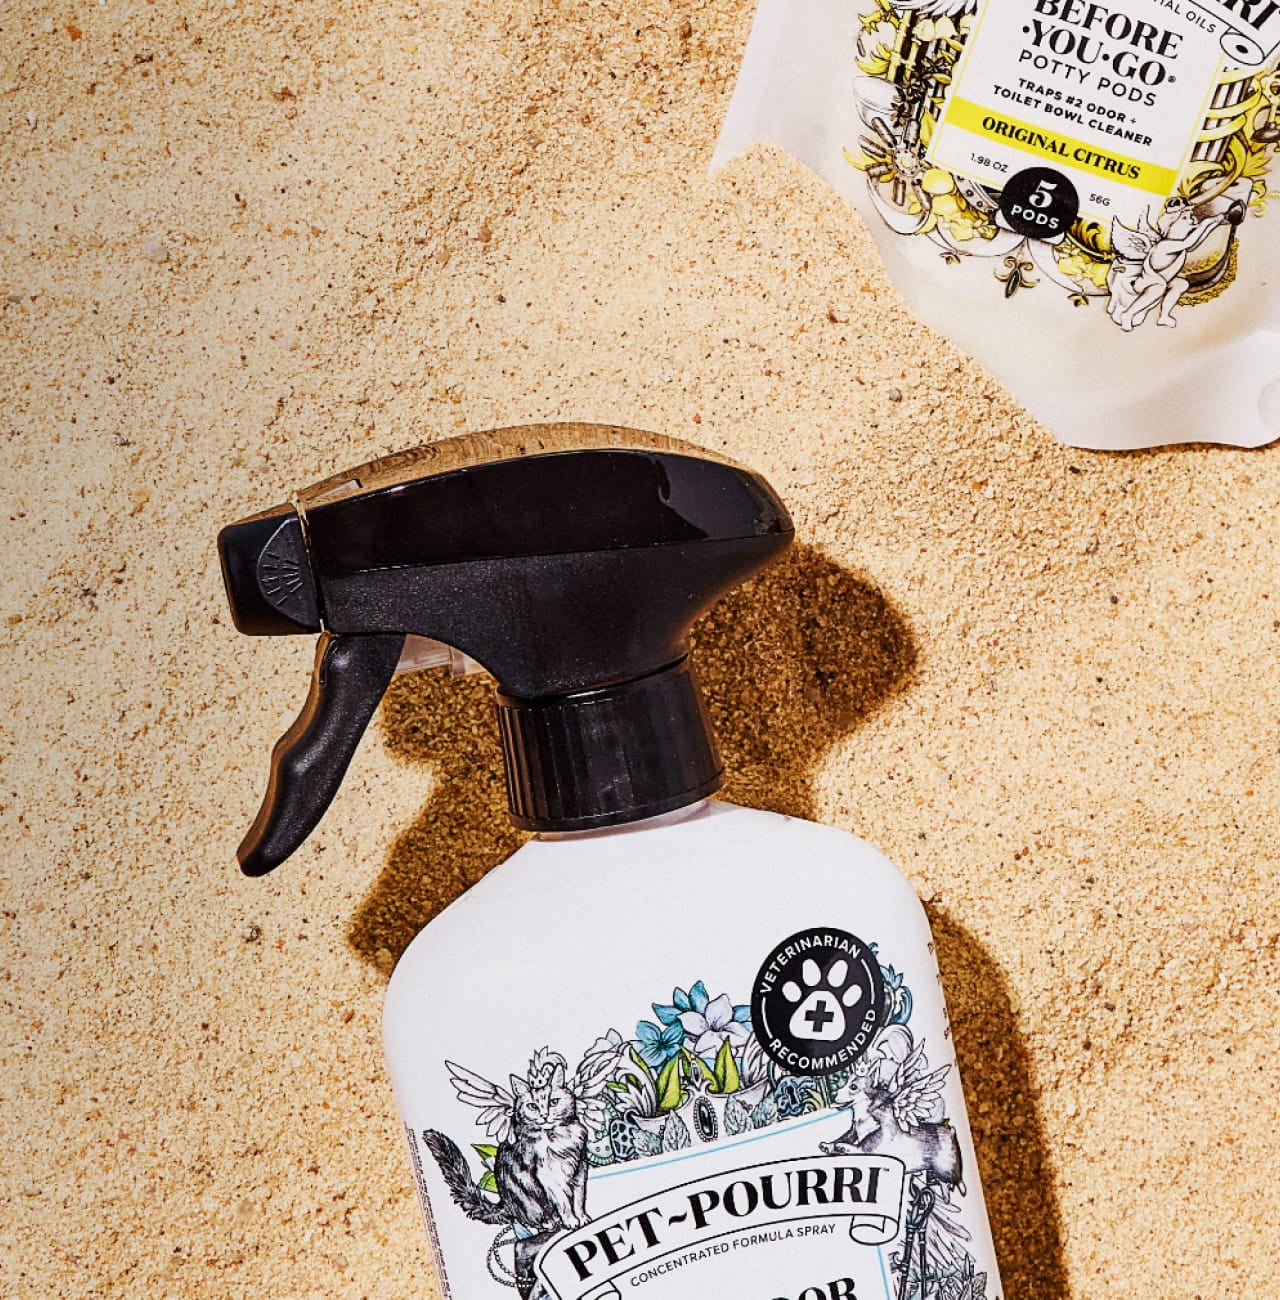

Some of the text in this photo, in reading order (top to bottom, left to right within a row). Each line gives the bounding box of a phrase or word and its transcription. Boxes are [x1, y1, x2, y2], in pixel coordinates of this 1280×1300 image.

[1034, 0, 1183, 59] BEFORE
[1186, 10, 1217, 33] OILS
[1018, 49, 1157, 106] POTTY PODS
[1018, 78, 1063, 100] TRAPS
[1065, 96, 1083, 108] #2
[1086, 103, 1126, 123] ODOR
[993, 85, 1153, 146] TOILET BOWL CLEANER
[970, 153, 1009, 173] 1.98 OZ
[982, 116, 1141, 180] ORIGINAL CITRUS
[1010, 205, 1060, 229] PODS
[1028, 179, 1059, 208] 5
[1089, 193, 1112, 207] 56G
[760, 934, 861, 993] VETERINARIAN
[769, 1009, 876, 1070] RECOMMENDED
[630, 1223, 836, 1288] CONCENTRATED FORMULA SPRAY
